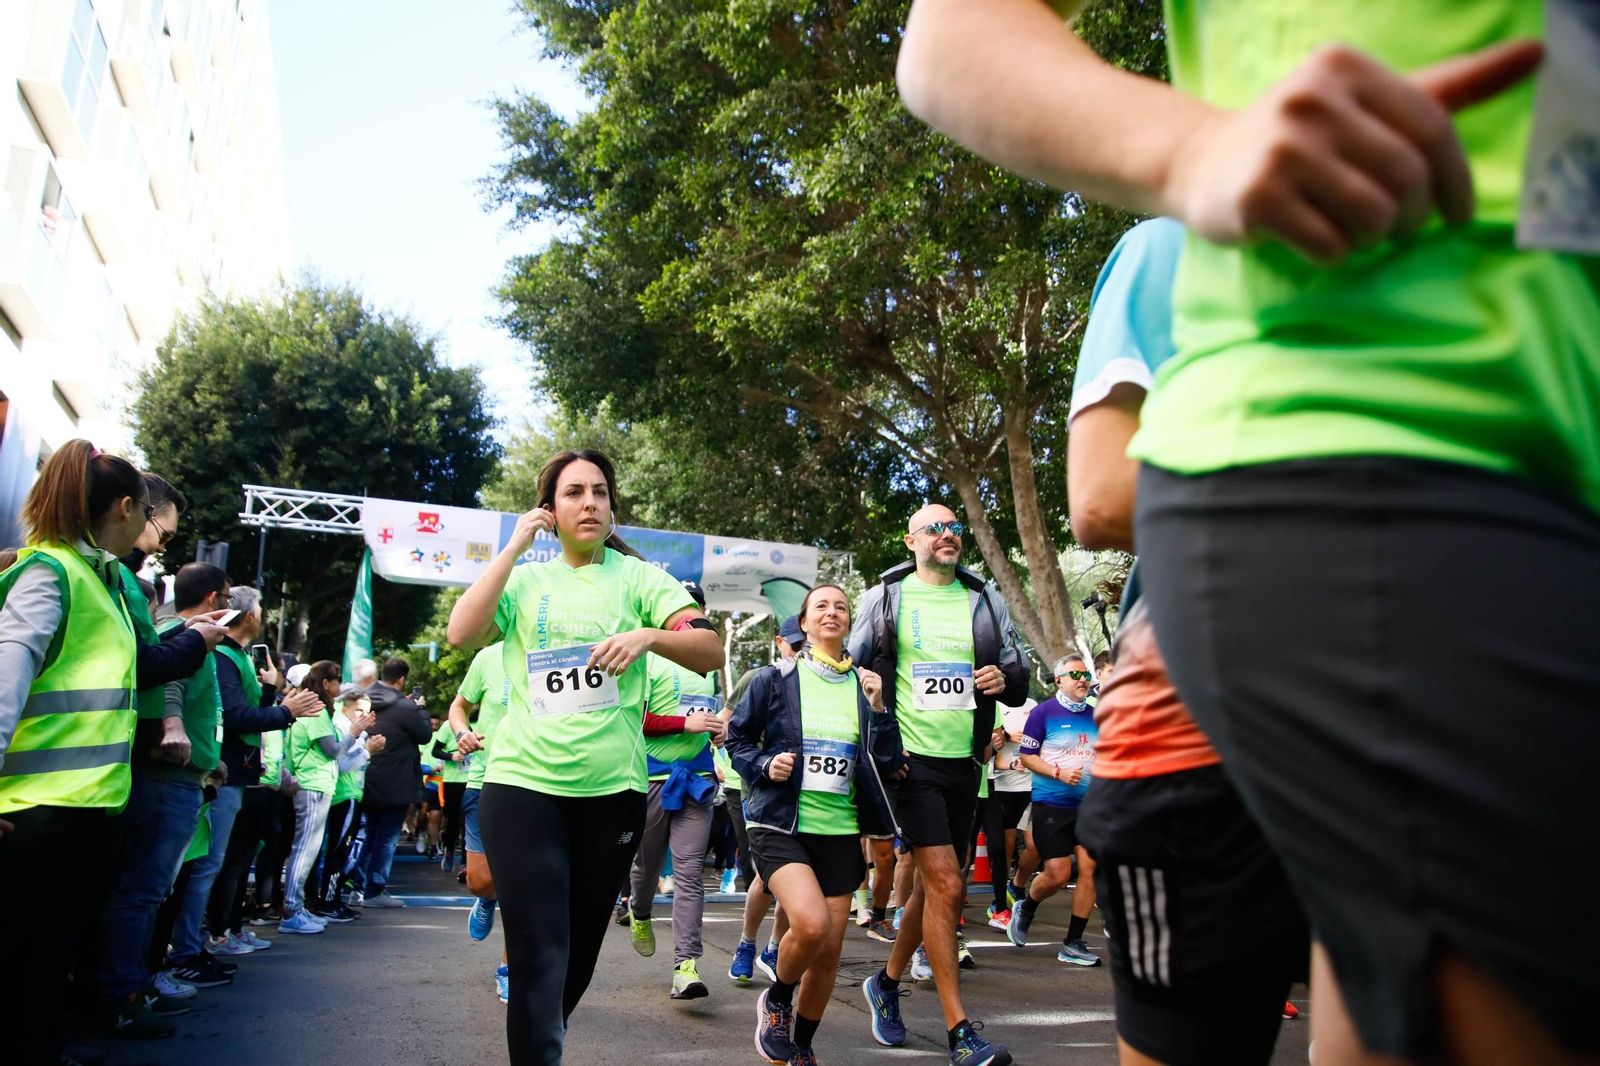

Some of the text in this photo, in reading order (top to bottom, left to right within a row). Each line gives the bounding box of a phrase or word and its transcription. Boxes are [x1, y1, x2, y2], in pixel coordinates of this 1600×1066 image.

[624, 537, 692, 556] marcha
[537, 594, 550, 650] ALMERÍA
[550, 608, 567, 619] En
[550, 621, 600, 636] contra
[530, 659, 551, 667] contra
[551, 657, 557, 665] el
[546, 666, 603, 694] 616
[925, 678, 964, 694] 200
[808, 756, 848, 777] 582
